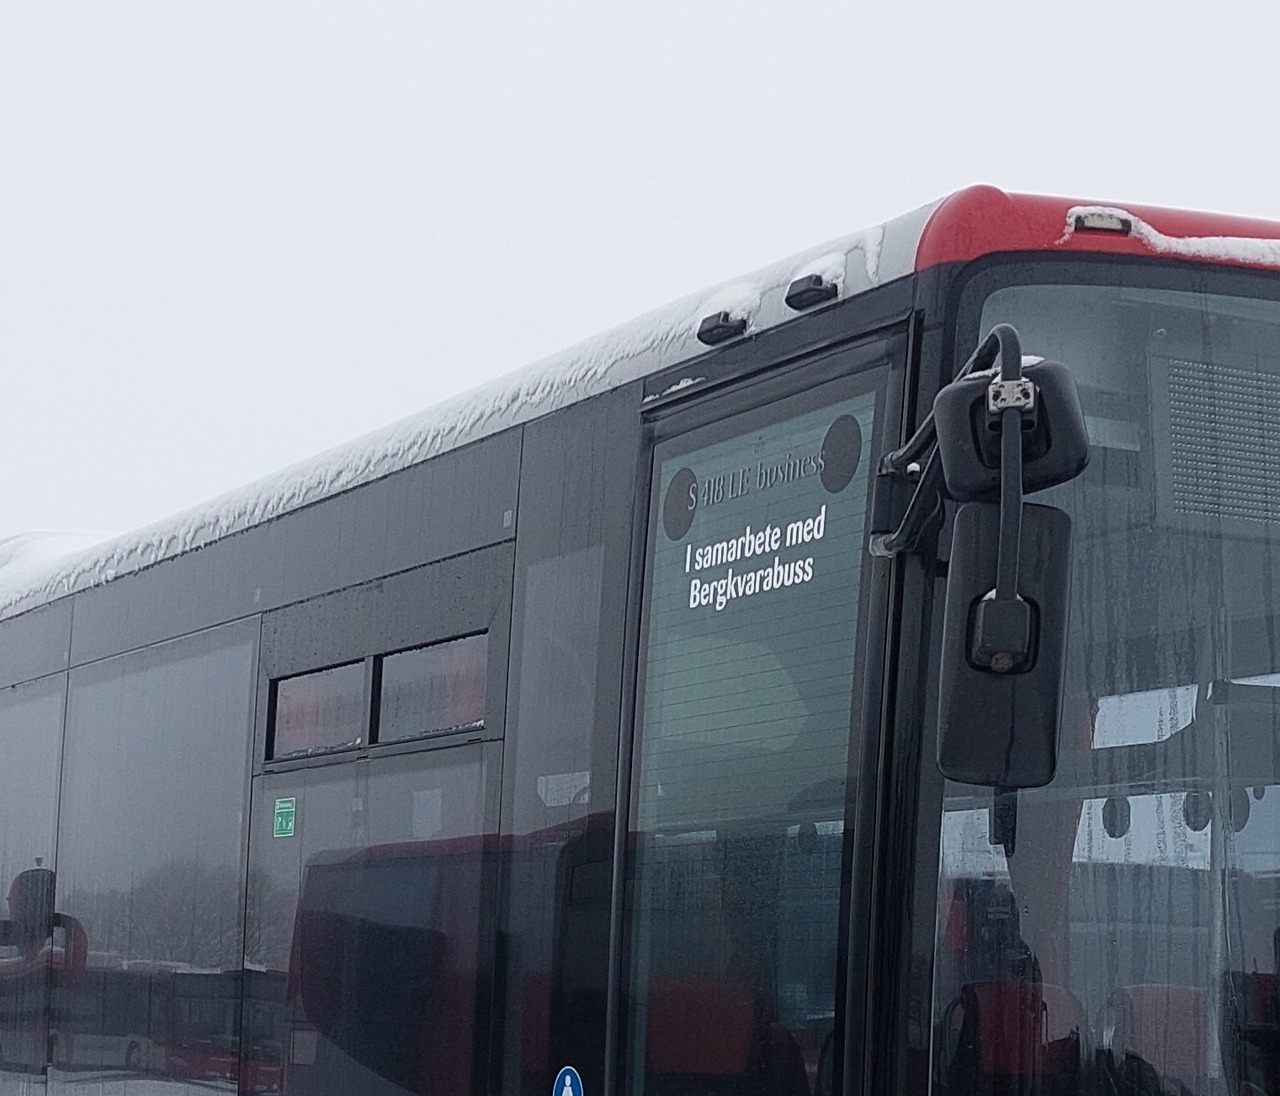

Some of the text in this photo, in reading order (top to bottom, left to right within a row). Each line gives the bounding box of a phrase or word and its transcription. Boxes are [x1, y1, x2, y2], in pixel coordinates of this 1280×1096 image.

[687, 451, 826, 510] S 418 LE business
[685, 504, 827, 573] I samarbete med
[689, 556, 814, 611] Bergkvarabuss
